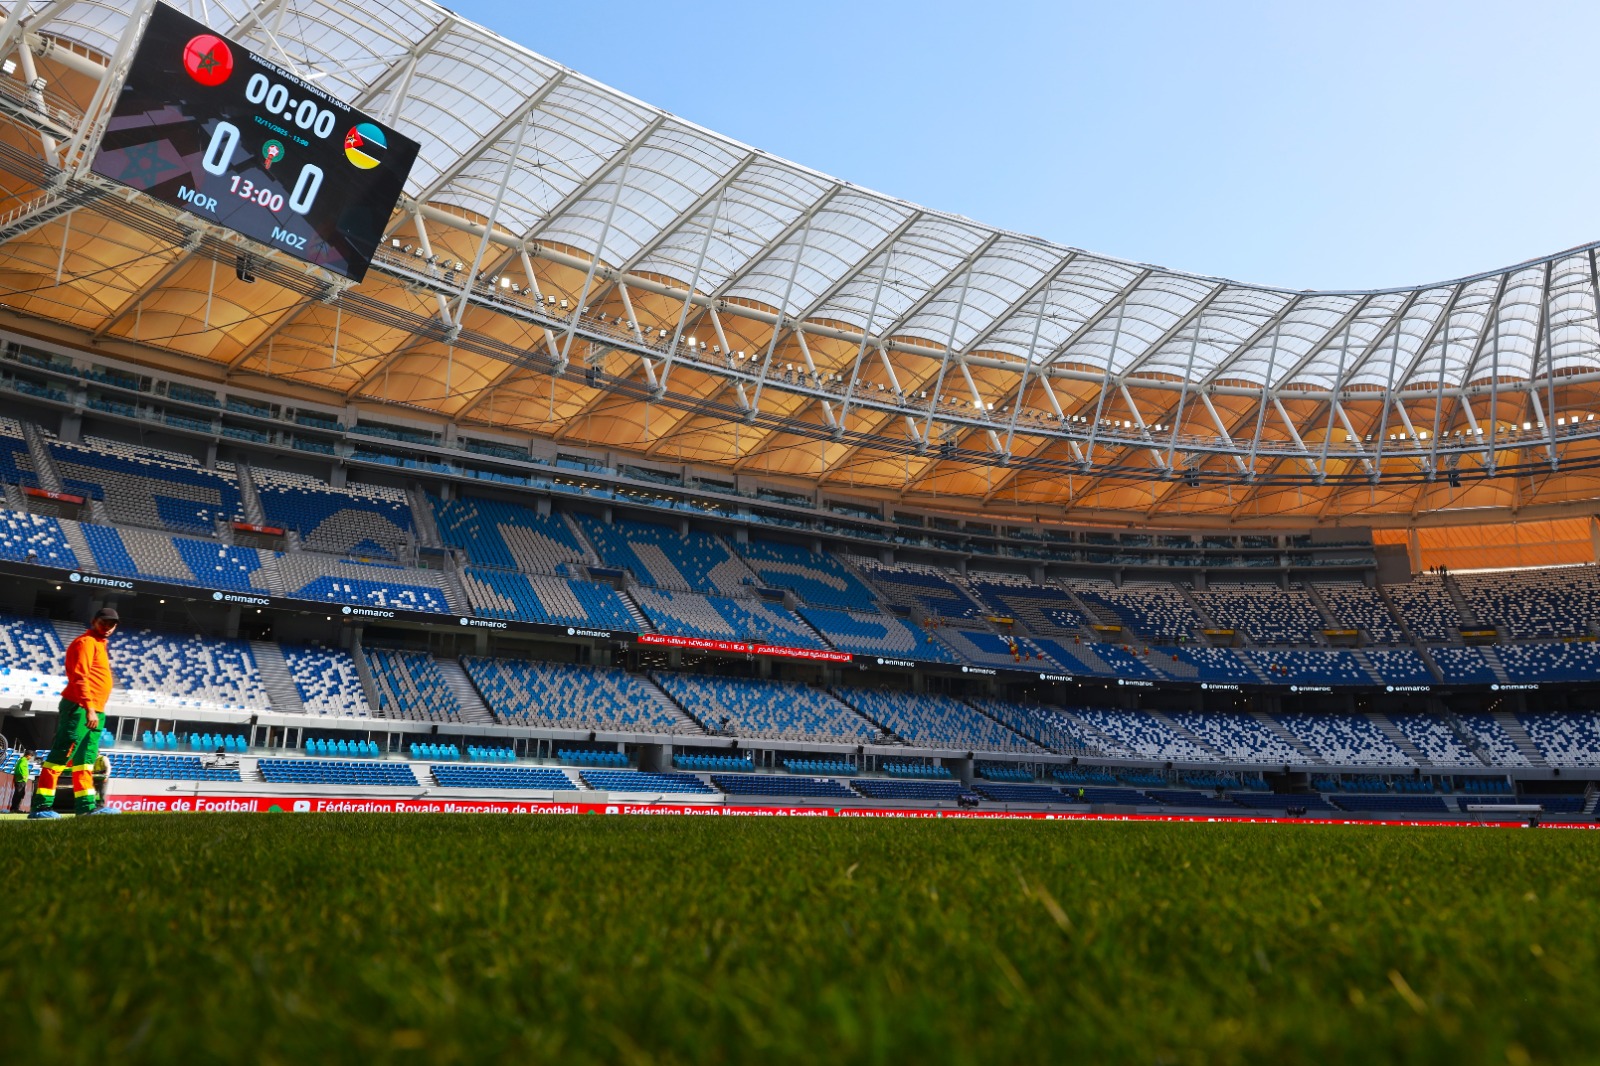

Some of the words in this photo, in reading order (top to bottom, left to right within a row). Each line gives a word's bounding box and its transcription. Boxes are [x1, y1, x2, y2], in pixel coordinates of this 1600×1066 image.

[248, 52, 276, 72] TANGIER
[276, 67, 300, 84] GRAND
[299, 81, 327, 100] STADIUM
[245, 72, 336, 139] 00:00
[202, 121, 241, 176] 0
[228, 175, 283, 213] 13:00
[288, 163, 324, 215] 0
[176, 185, 218, 213] MOR
[271, 226, 307, 251] MOZ
[82, 575, 134, 589] enmaroc
[224, 594, 270, 606] enmaroc
[352, 607, 395, 618] enmaroc
[469, 619, 507, 629] enmaroc
[576, 629, 611, 638] enmaroc
[884, 659, 915, 668] enmaroc
[106, 800, 166, 811] rocaine
[170, 799, 190, 812] de
[195, 799, 258, 812] Football
[317, 801, 391, 812] Fédération
[512, 804, 527, 813] de
